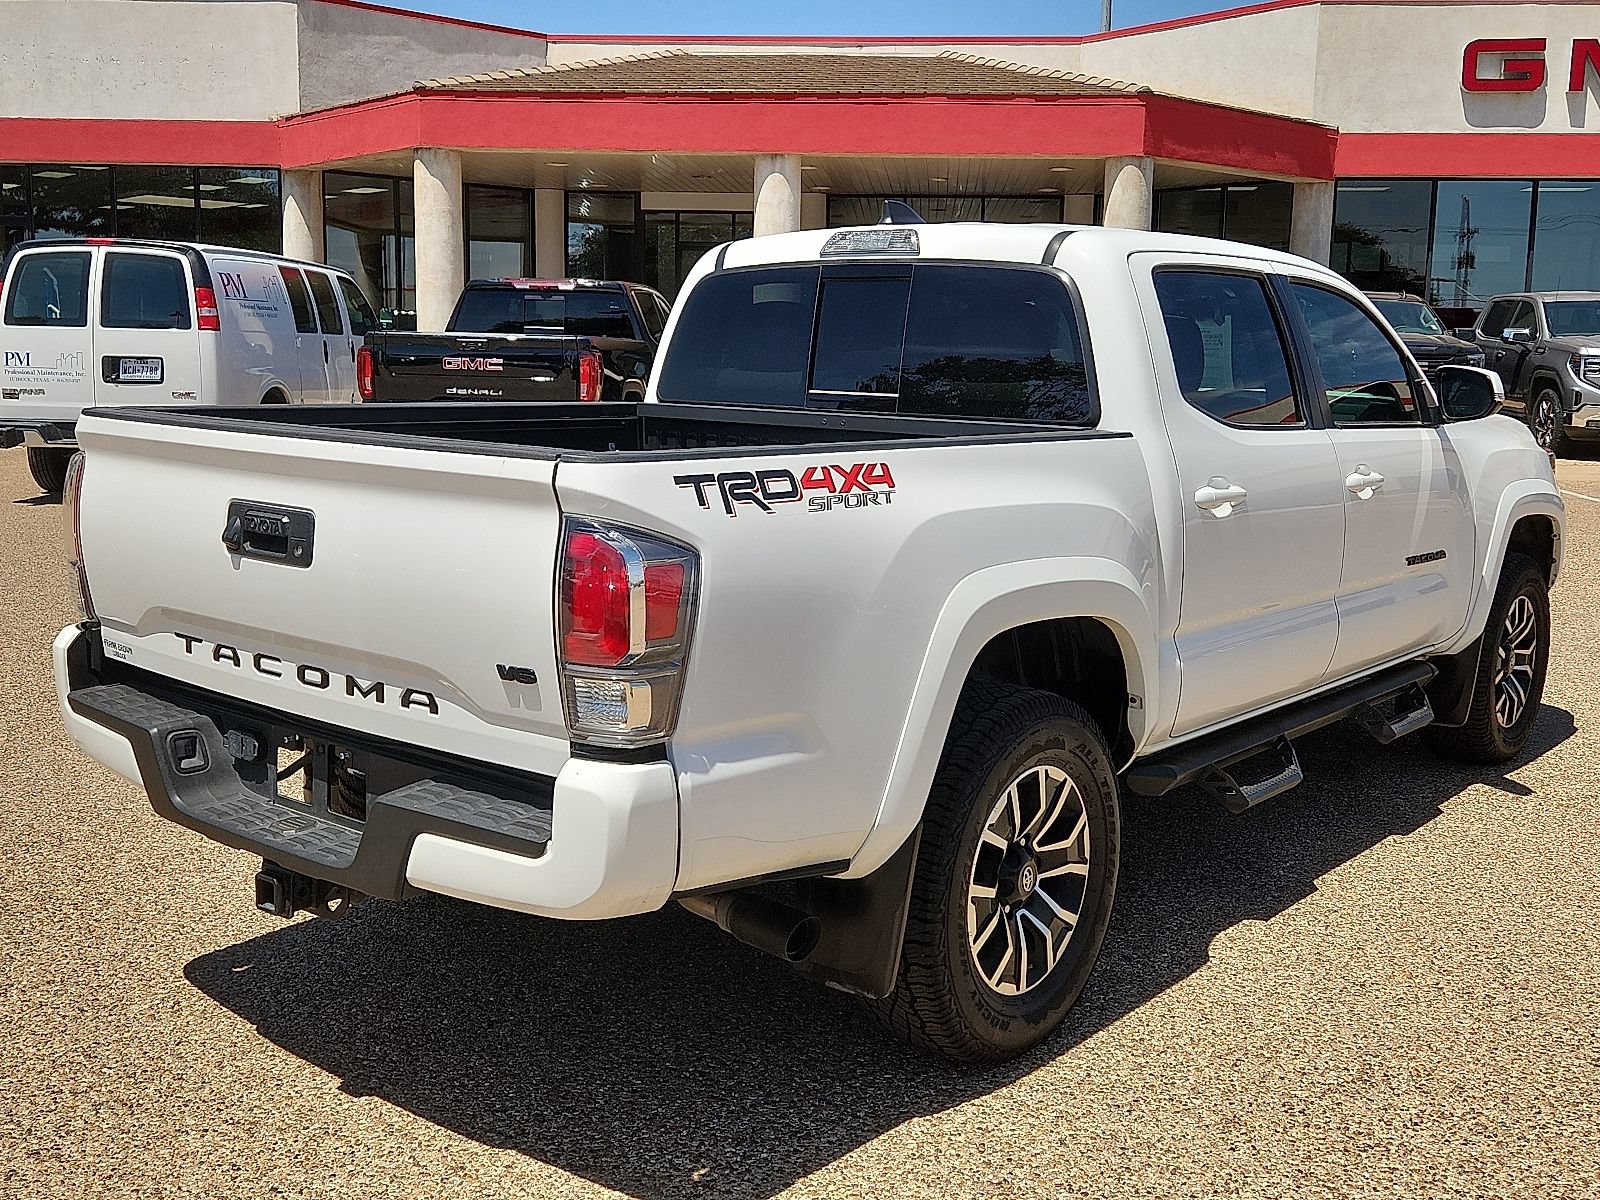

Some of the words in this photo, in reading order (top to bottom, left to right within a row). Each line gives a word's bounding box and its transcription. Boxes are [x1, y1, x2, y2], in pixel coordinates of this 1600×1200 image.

[217, 272, 249, 298] PM
[4, 351, 31, 367] PM
[443, 357, 504, 371] GMC
[37, 370, 74, 378] Maintenance,
[673, 468, 803, 518] TRD
[800, 462, 896, 494] 4X4
[808, 490, 896, 513] SPORT
[1405, 549, 1447, 567] TACOMA
[174, 632, 439, 716] TACOMA
[495, 664, 538, 685] V6
